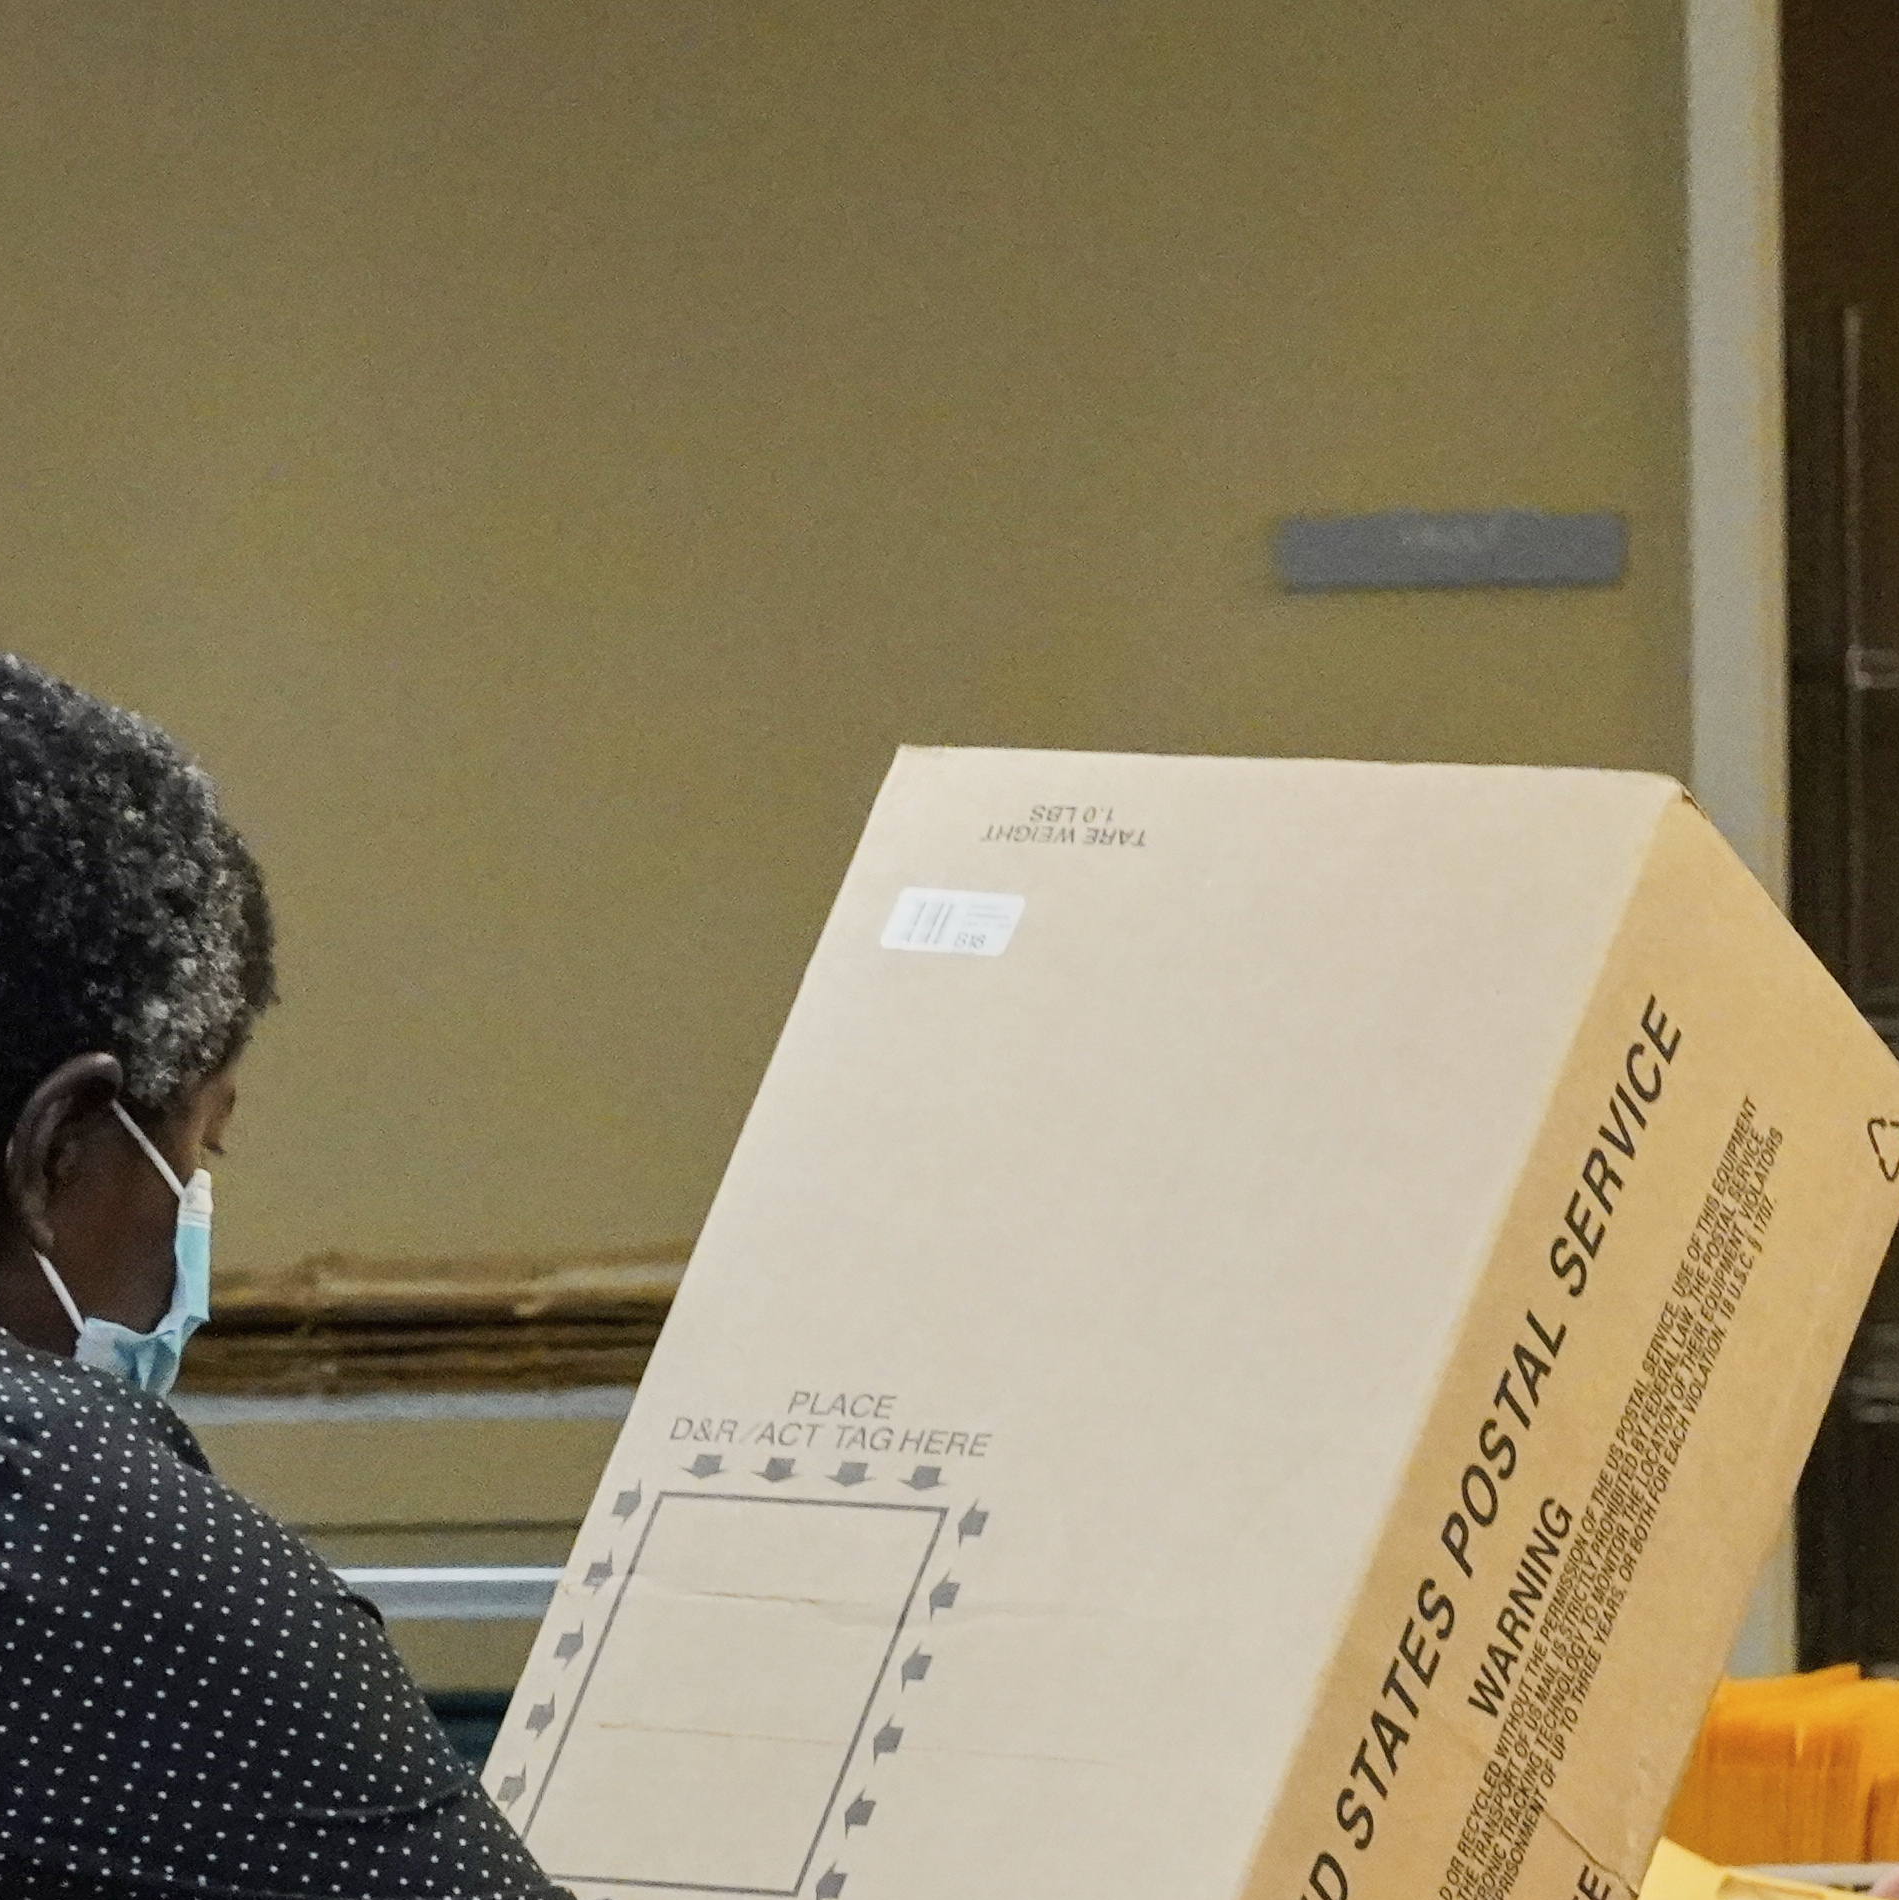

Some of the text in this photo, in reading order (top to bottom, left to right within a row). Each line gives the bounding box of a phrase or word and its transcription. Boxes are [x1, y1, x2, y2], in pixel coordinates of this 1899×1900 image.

[980, 823, 1147, 848] TARE WEIGHT
[1030, 804, 1079, 823] LBS
[788, 1390, 898, 1419] PLACE
[834, 1424, 895, 1451] TAG
[899, 1429, 994, 1457] HERE
[1336, 1578, 1454, 1849] STATES
[1441, 1311, 1566, 1577] POSTAL
[1550, 995, 1680, 1296] SERVICE
[1457, 1760, 1502, 1857] RECYCLED
[1496, 1677, 1532, 1759] WITHOUT
[1525, 1641, 1548, 1676] THE
[1540, 1532, 1588, 1641] PERMISSION
[1590, 1469, 1613, 1507] THE
[1615, 1379, 1648, 1445] POSTAL
[1671, 1260, 1693, 1297] USE
[1696, 1194, 1720, 1234] THIS
[1711, 1095, 1756, 1196] EQUIPMENT
[1472, 1757, 1520, 1866] TRANSPORT
[1534, 1662, 1559, 1704] MAIL
[1558, 1554, 1597, 1641] STRICTLY
[1590, 1452, 1638, 1558] PROHIBITED
[1640, 1349, 1680, 1427] FEDERAL
[1688, 1267, 1710, 1303] THE
[1701, 1204, 1736, 1269] POSTAL
[1727, 1127, 1764, 1202] SERVICE
[1500, 1751, 1542, 1842] TRACKING
[1535, 1629, 1587, 1750] TECHNOLOGY
[1591, 1523, 1629, 1605] MONITOR
[1621, 1485, 1645, 1522] THE
[1636, 1398, 1677, 1489] LOCATION
[1679, 1321, 1707, 1373] THEIR
[1738, 1127, 1783, 1220] VIOLATORS
[1468, 1498, 1572, 1716] WARNING
